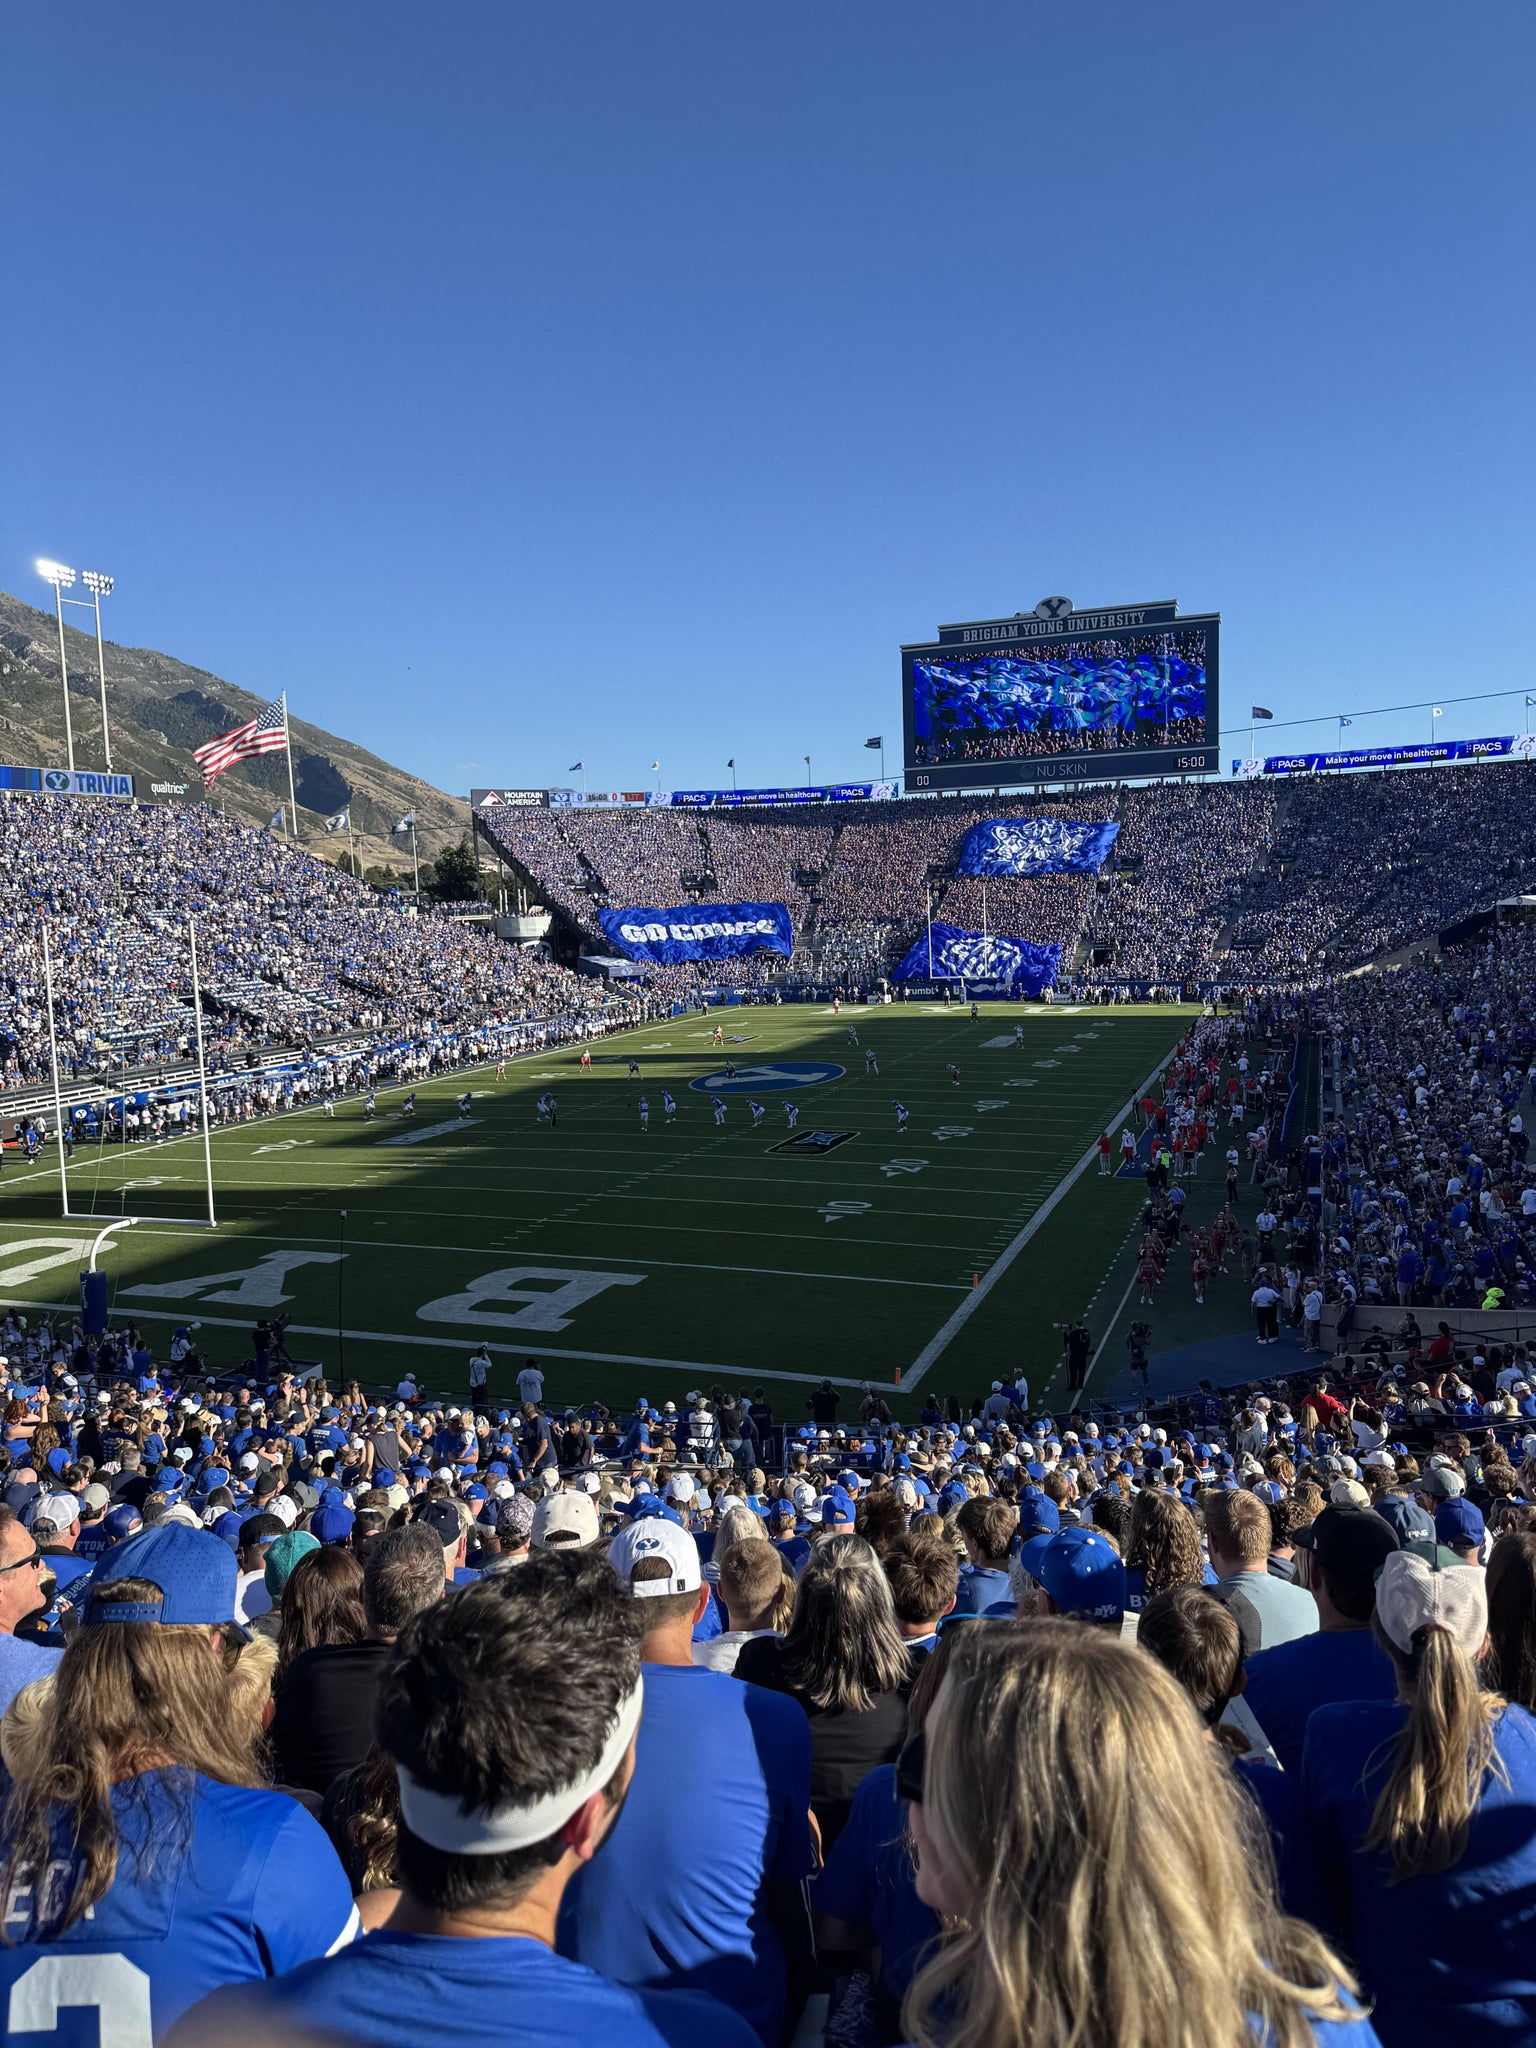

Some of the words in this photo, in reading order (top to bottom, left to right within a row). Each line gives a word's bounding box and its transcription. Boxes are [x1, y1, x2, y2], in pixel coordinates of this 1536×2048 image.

[963, 625, 1019, 643] BRIGHAM
[1023, 620, 1064, 636] YOUNG
[1068, 611, 1146, 632] UNIVERSITY
[1473, 742, 1502, 753] PACS
[1177, 756, 1205, 768] 15:00
[1325, 755, 1349, 765] Make
[1350, 754, 1369, 765] your
[1369, 753, 1393, 762] move
[1394, 751, 1402, 760] in
[1403, 748, 1448, 759] healthcare
[1278, 759, 1305, 769] PACS
[1037, 765, 1056, 777] NU
[1059, 763, 1087, 776] SKIN
[75, 774, 131, 796] TRIVIA
[151, 781, 184, 796] qualtrics
[504, 791, 543, 799] MOUNTAIN
[722, 793, 741, 801] Make
[742, 794, 758, 802] your
[758, 792, 777, 800] move
[785, 791, 821, 799] healthcare
[841, 788, 864, 797] PACS
[683, 794, 706, 803] PACS
[620, 923, 668, 943] GO
[909, 987, 935, 995] rumbl
[1408, 1529, 1429, 1538] PING
[1094, 1604, 1117, 1618] BYU
